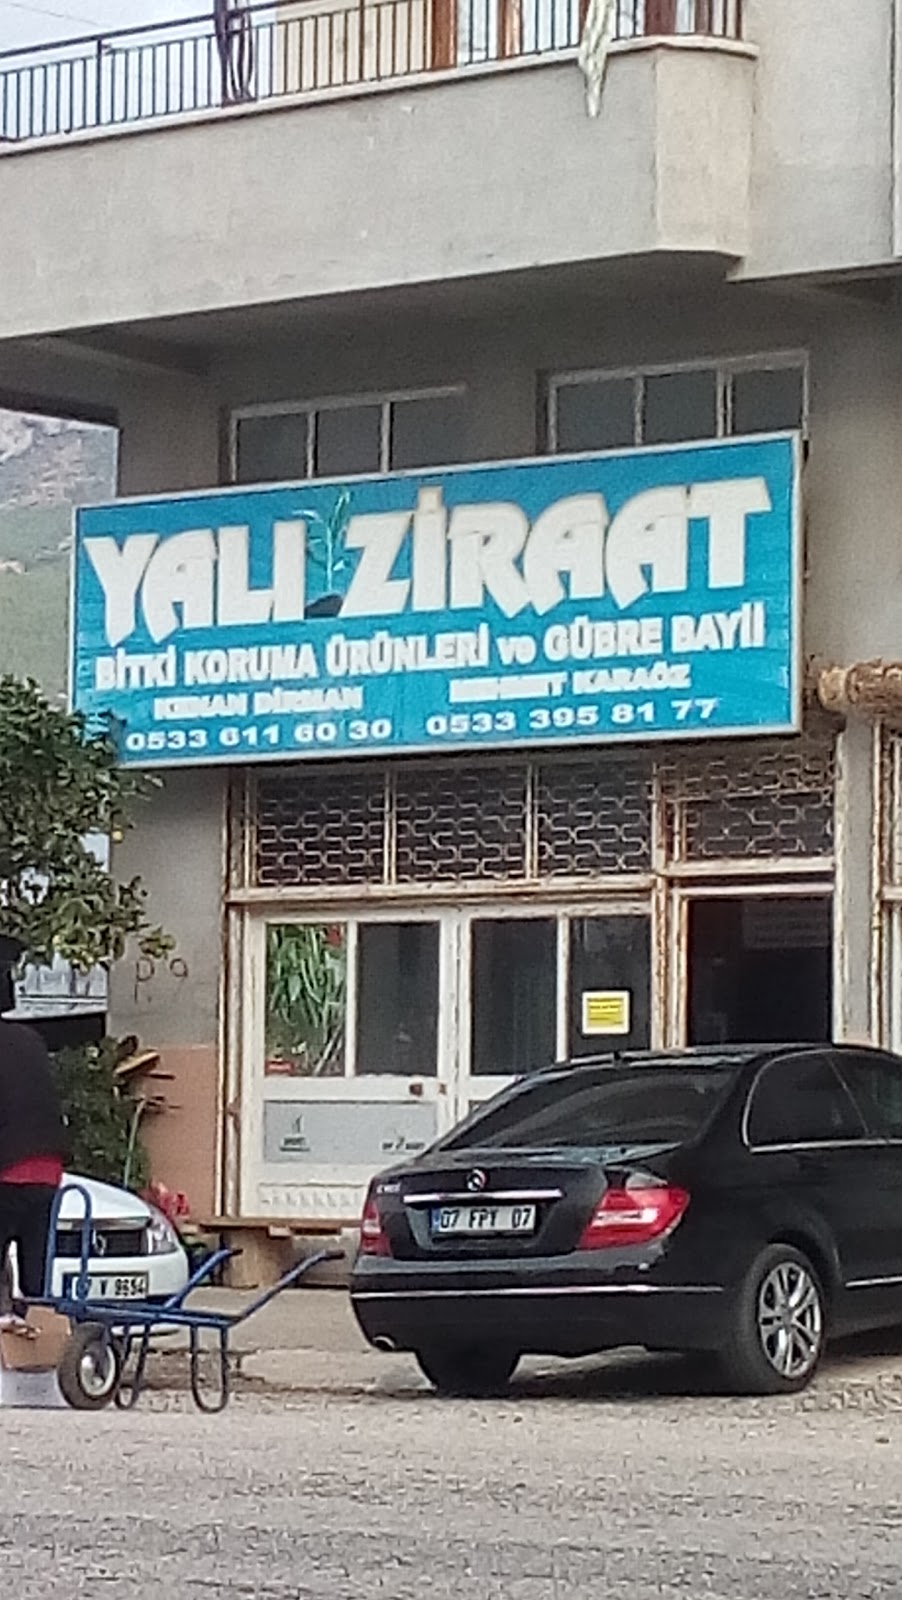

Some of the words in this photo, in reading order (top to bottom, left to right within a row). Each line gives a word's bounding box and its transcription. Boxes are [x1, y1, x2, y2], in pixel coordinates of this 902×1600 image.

[84, 519, 306, 648] YALI
[338, 476, 772, 619] ZİRAAT
[95, 645, 176, 691] BİTKİ
[184, 643, 318, 686] KORUMA
[325, 622, 490, 676] ÜRÜNLERİ
[544, 615, 663, 662] GÜBRE
[126, 729, 207, 750] 0533
[219, 725, 280, 746] 611
[294, 722, 338, 742] 60
[348, 720, 392, 740] 30
[426, 710, 516, 735] 0533
[529, 705, 599, 728] 395
[612, 702, 655, 724] 81
[671, 699, 719, 721] 77
[440, 1209, 459, 1229] 07
[512, 1207, 532, 1228] 07
